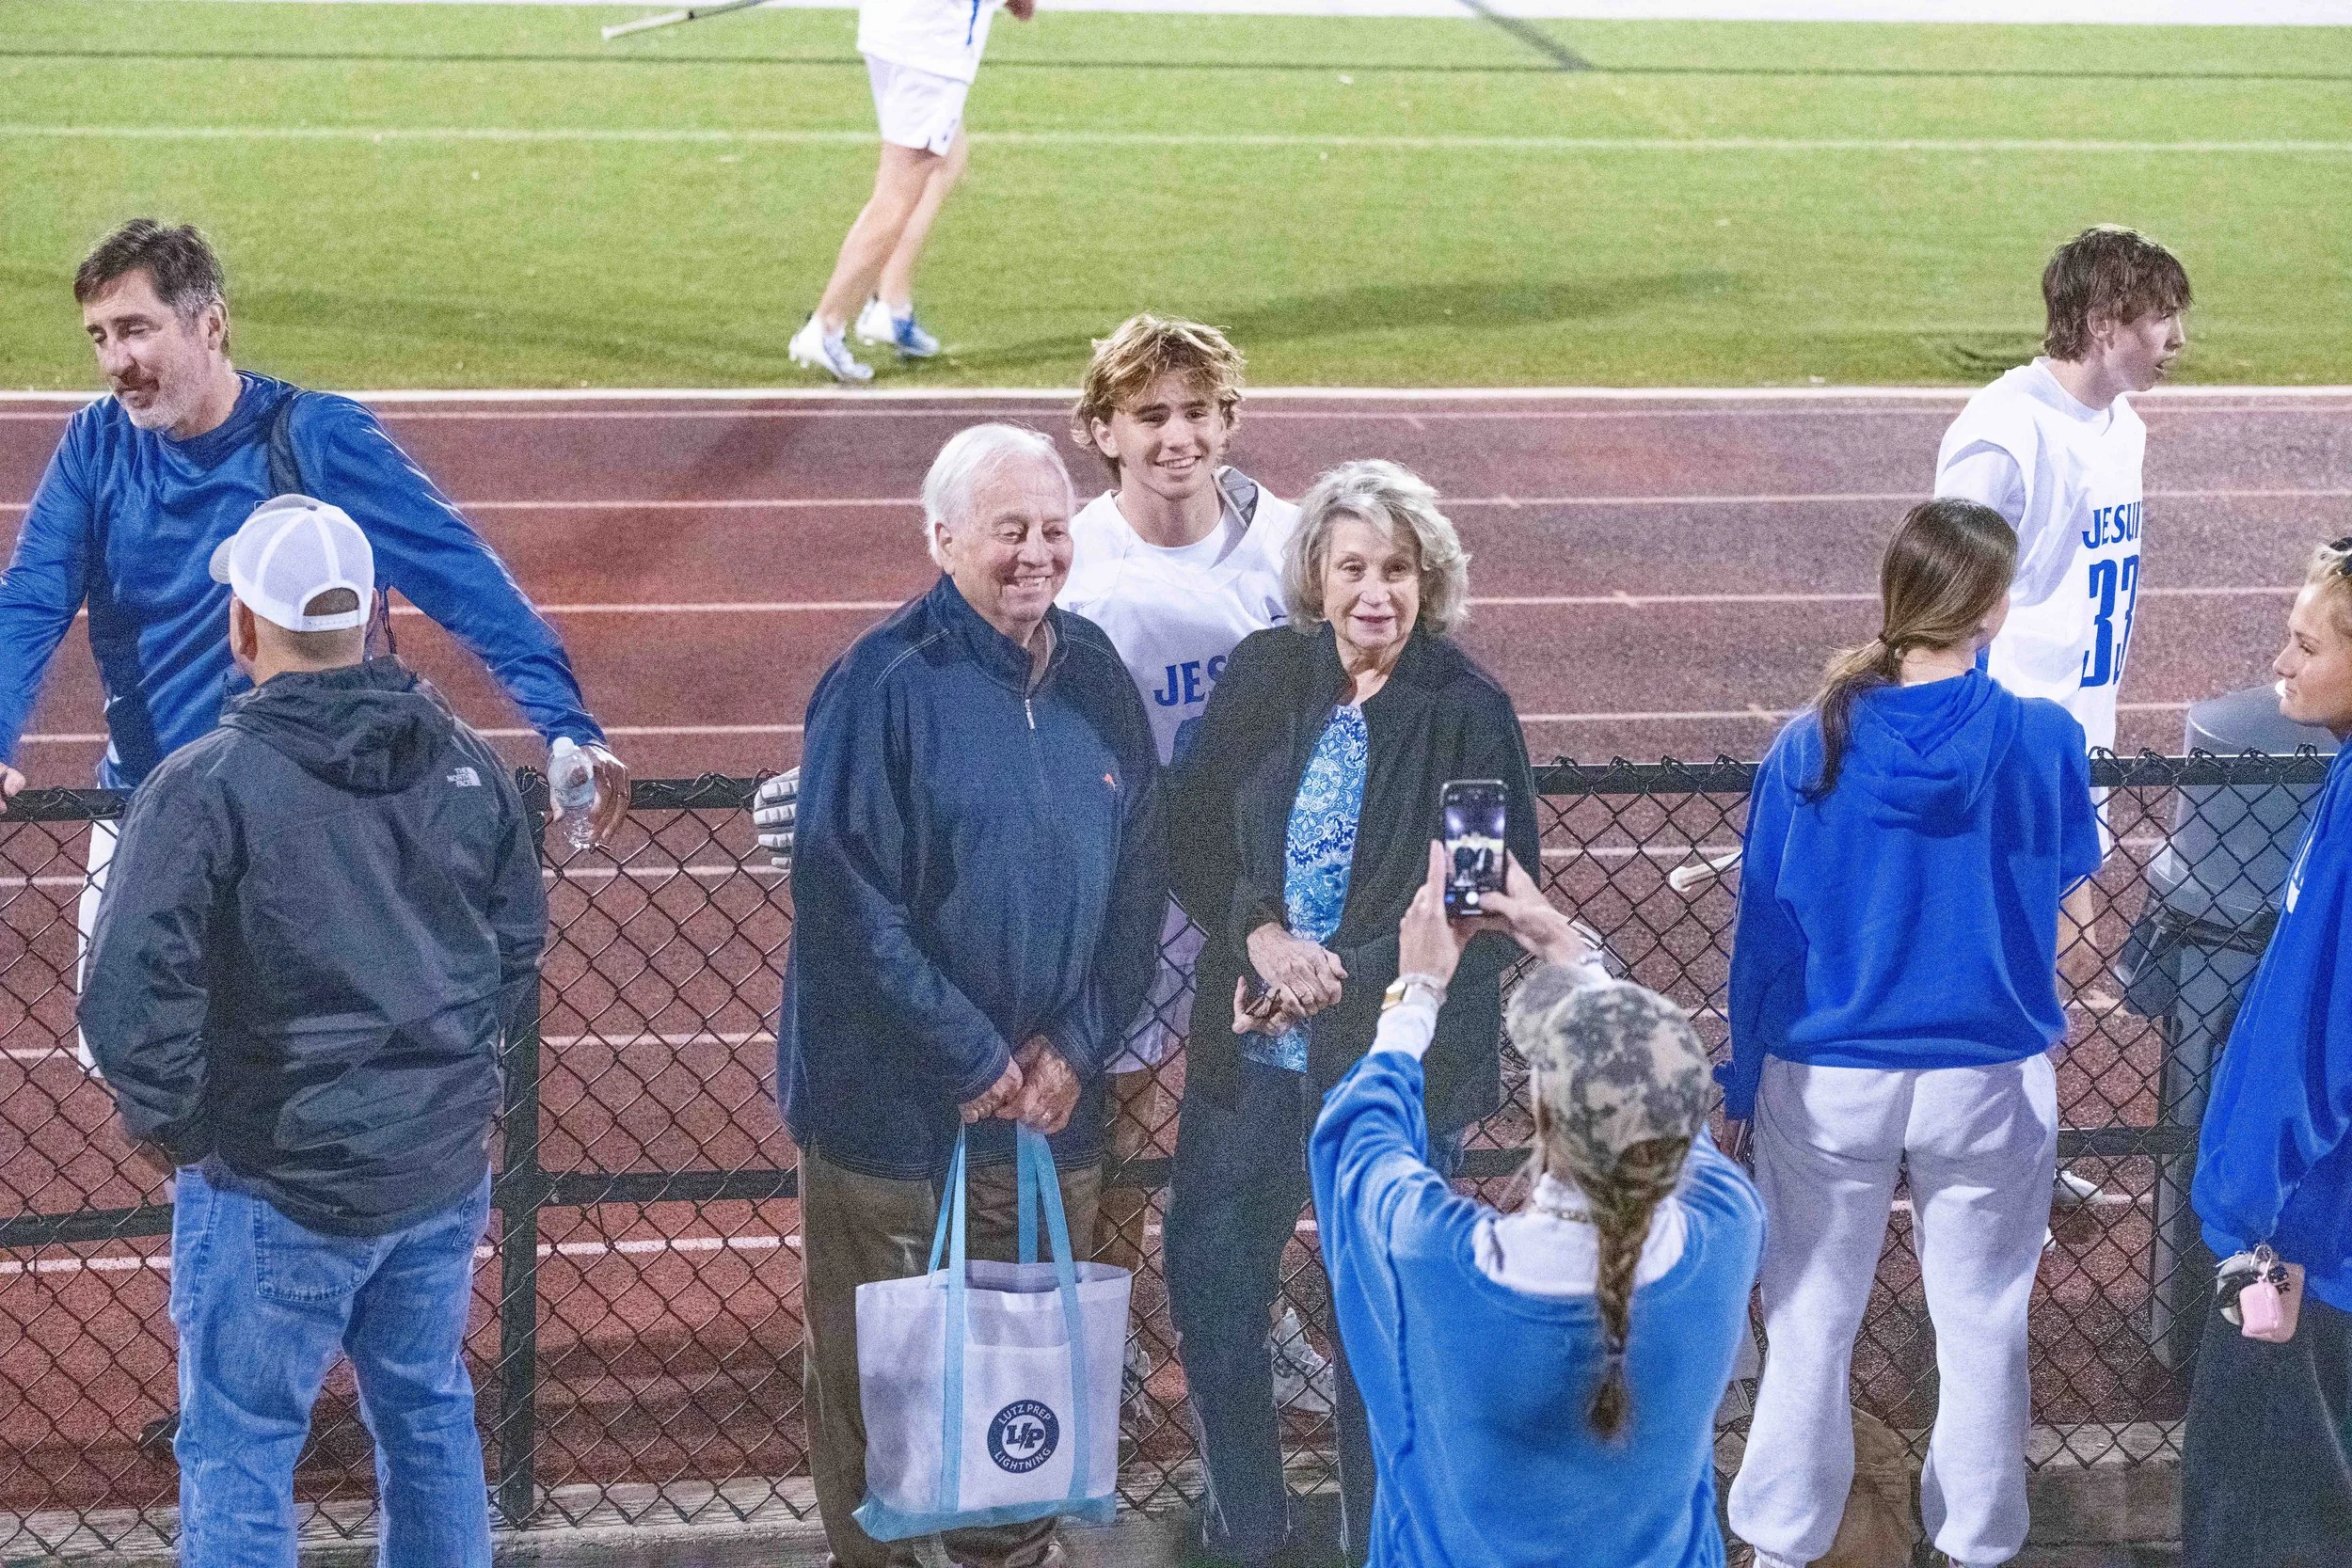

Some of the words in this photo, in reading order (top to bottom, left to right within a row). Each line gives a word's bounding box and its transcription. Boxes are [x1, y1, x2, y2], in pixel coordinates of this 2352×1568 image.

[2082, 501, 2144, 548] JESUI
[2078, 554, 2139, 690] 33
[997, 1403, 1025, 1425] LUTZ
[1026, 1403, 1052, 1421] PREP
[994, 1448, 1052, 1471] LIGHTNING
